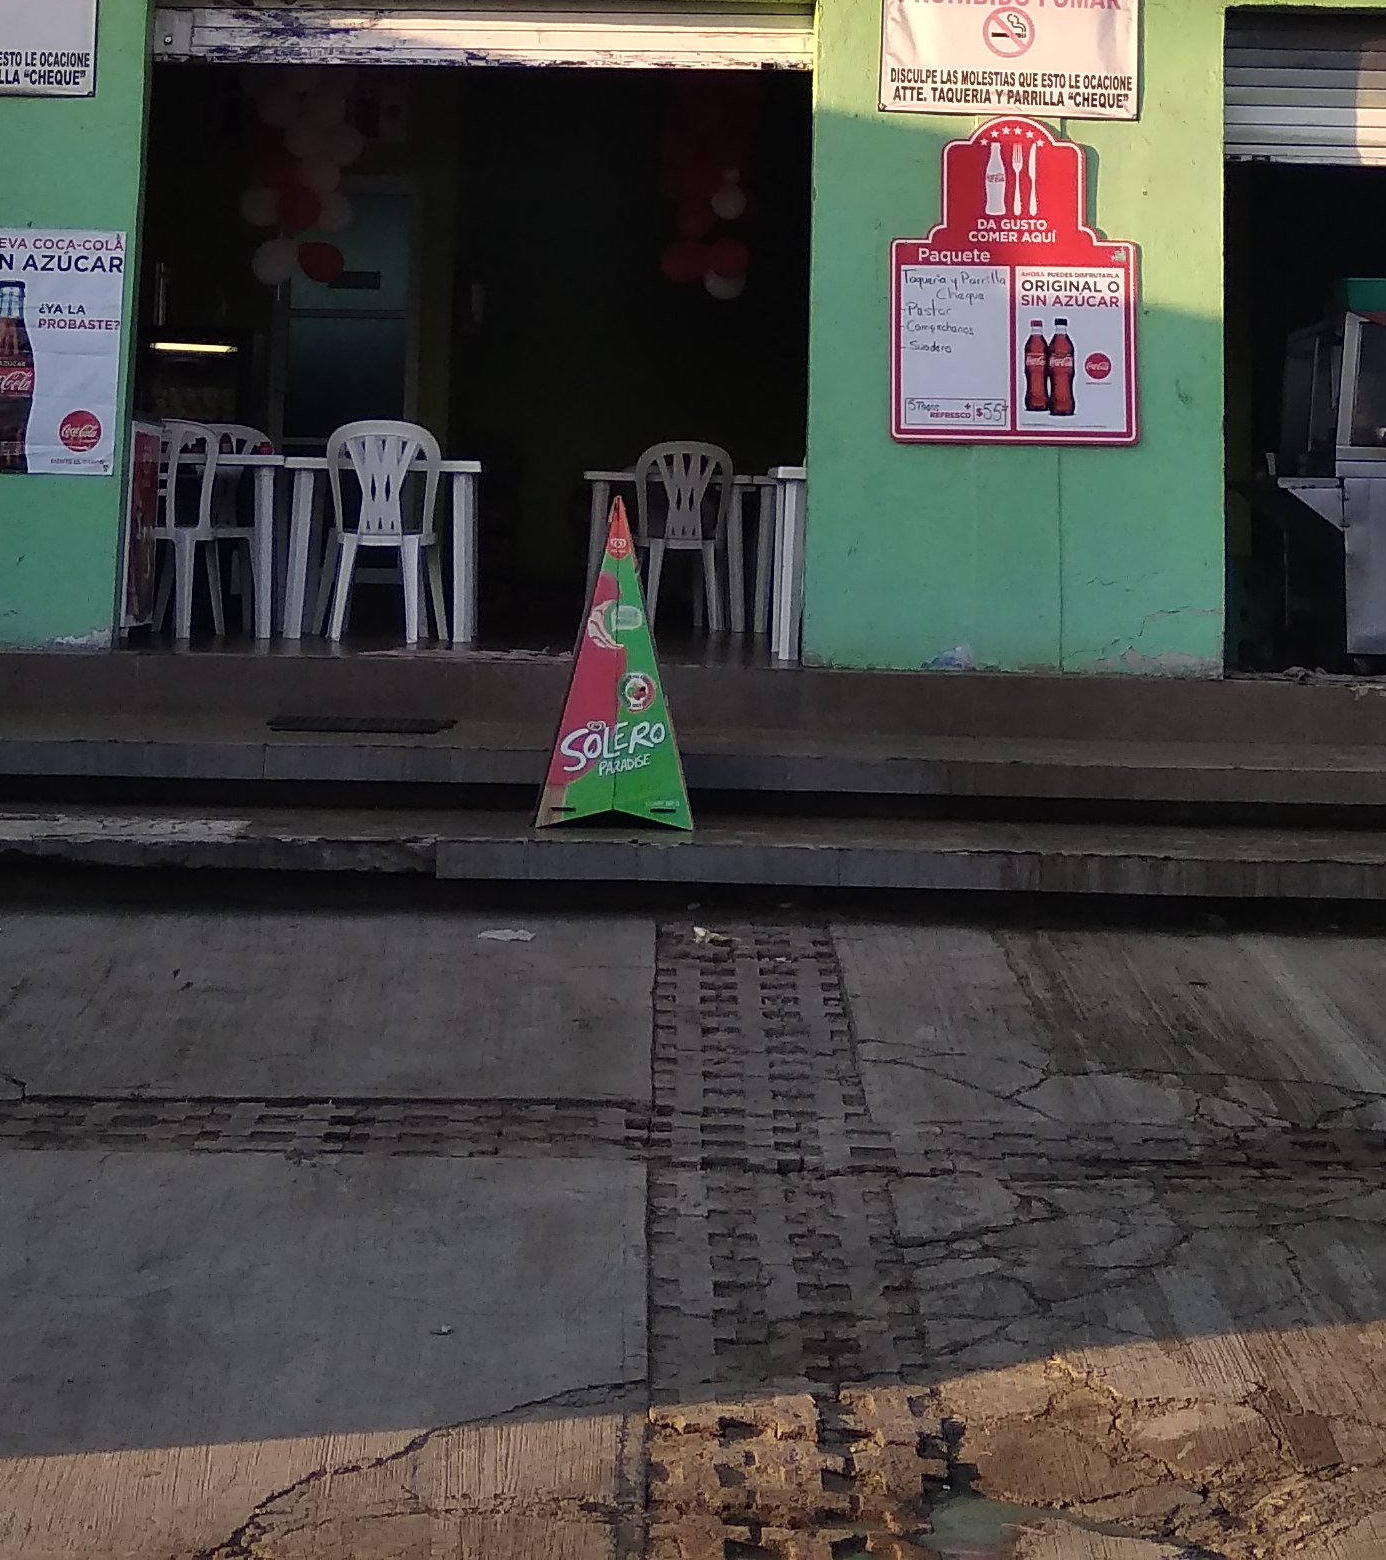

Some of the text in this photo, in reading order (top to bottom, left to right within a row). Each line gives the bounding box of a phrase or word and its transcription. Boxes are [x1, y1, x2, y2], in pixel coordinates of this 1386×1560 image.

[24, 51, 38, 68] LE
[39, 51, 90, 69] OCACIONE
[890, 68, 1132, 92] DISCULPE LAS MOLESTIAS QUE ESTO LE OCACIONE
[893, 86, 928, 102] ATTE.
[931, 87, 992, 104] TAQUERIA
[995, 88, 1004, 105] Y
[1007, 89, 1064, 107] PARRILLA
[977, 219, 1048, 231] DA GUSTO
[968, 229, 1057, 243] COMER AQUÍ
[33, 238, 124, 252] COCA-COLA
[22, 251, 123, 274] AZÚCAR
[918, 247, 991, 265] Paquete
[1021, 279, 1120, 293] ORIGINAL O
[1021, 291, 1120, 308] SIN AZÚCAR
[38, 303, 86, 316] ¿YA LA
[37, 318, 120, 331] PROBASTE?
[930, 411, 971, 419] REFRESCO
[560, 721, 666, 772] SOLERO
[598, 754, 651, 776] PARADISE
